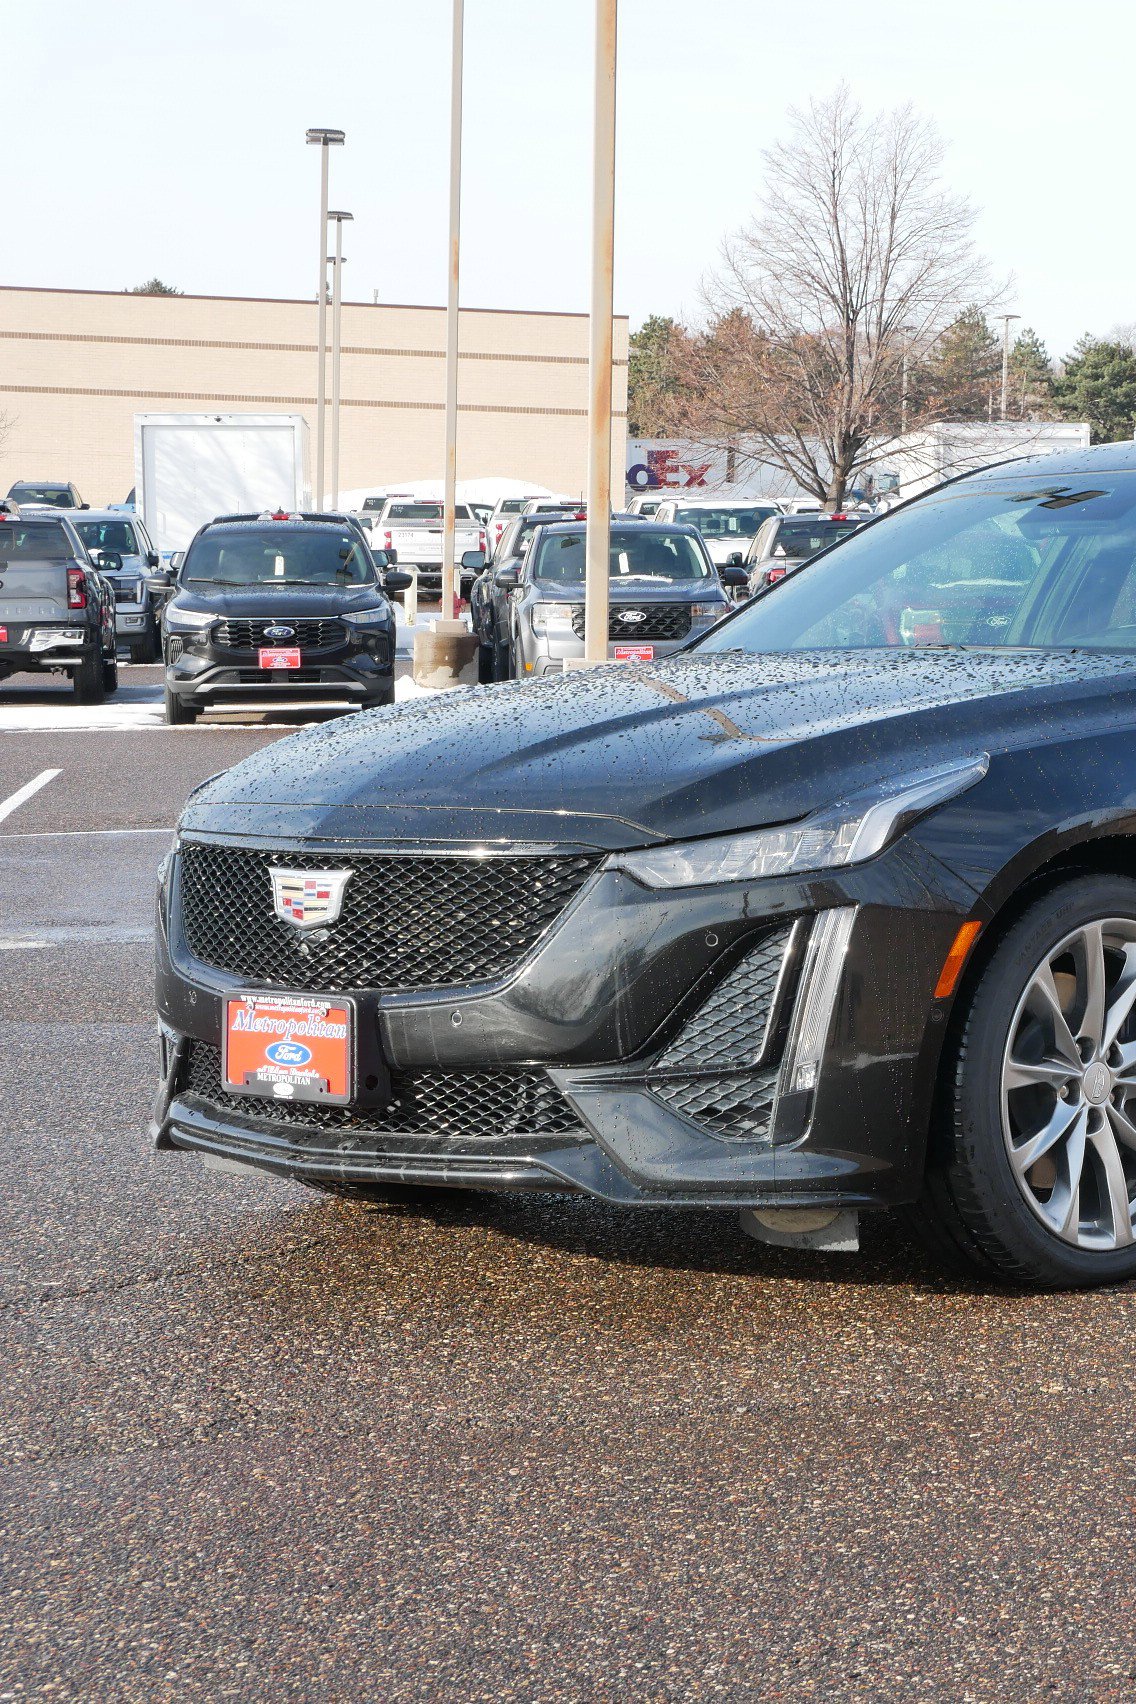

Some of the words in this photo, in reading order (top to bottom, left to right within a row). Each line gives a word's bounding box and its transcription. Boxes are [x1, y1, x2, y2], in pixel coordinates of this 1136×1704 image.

[626, 450, 712, 492] dEx
[241, 995, 331, 1010] www.metropolitanford.com
[232, 1010, 346, 1041] Metropolitan
[275, 1045, 303, 1062] Ford
[257, 1073, 311, 1085] METROPOLITAN
